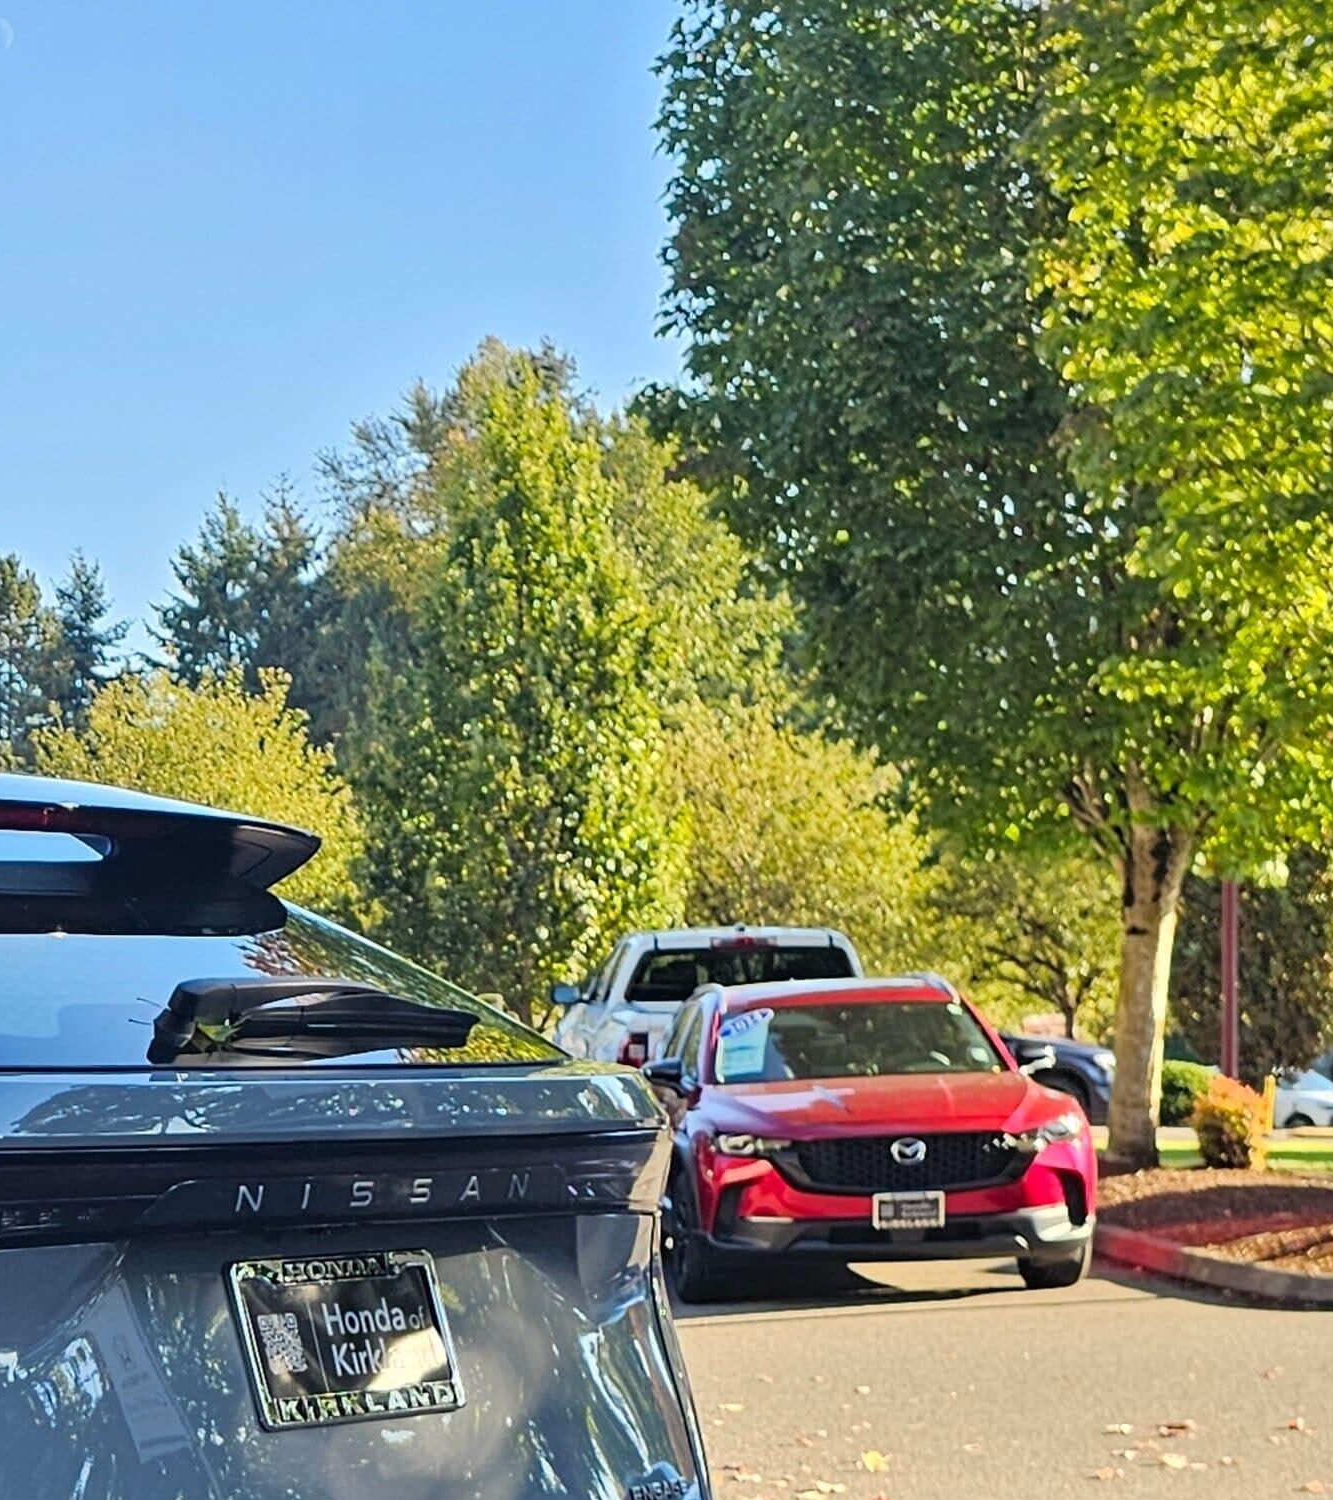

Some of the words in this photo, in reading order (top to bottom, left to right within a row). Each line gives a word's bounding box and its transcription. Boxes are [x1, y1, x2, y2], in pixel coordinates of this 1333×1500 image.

[235, 1172, 532, 1212] NISSAN
[284, 1257, 383, 1282] HONDA
[321, 1298, 406, 1336] Honda
[409, 1304, 429, 1330] of
[278, 1382, 456, 1423] KIRKLAND
